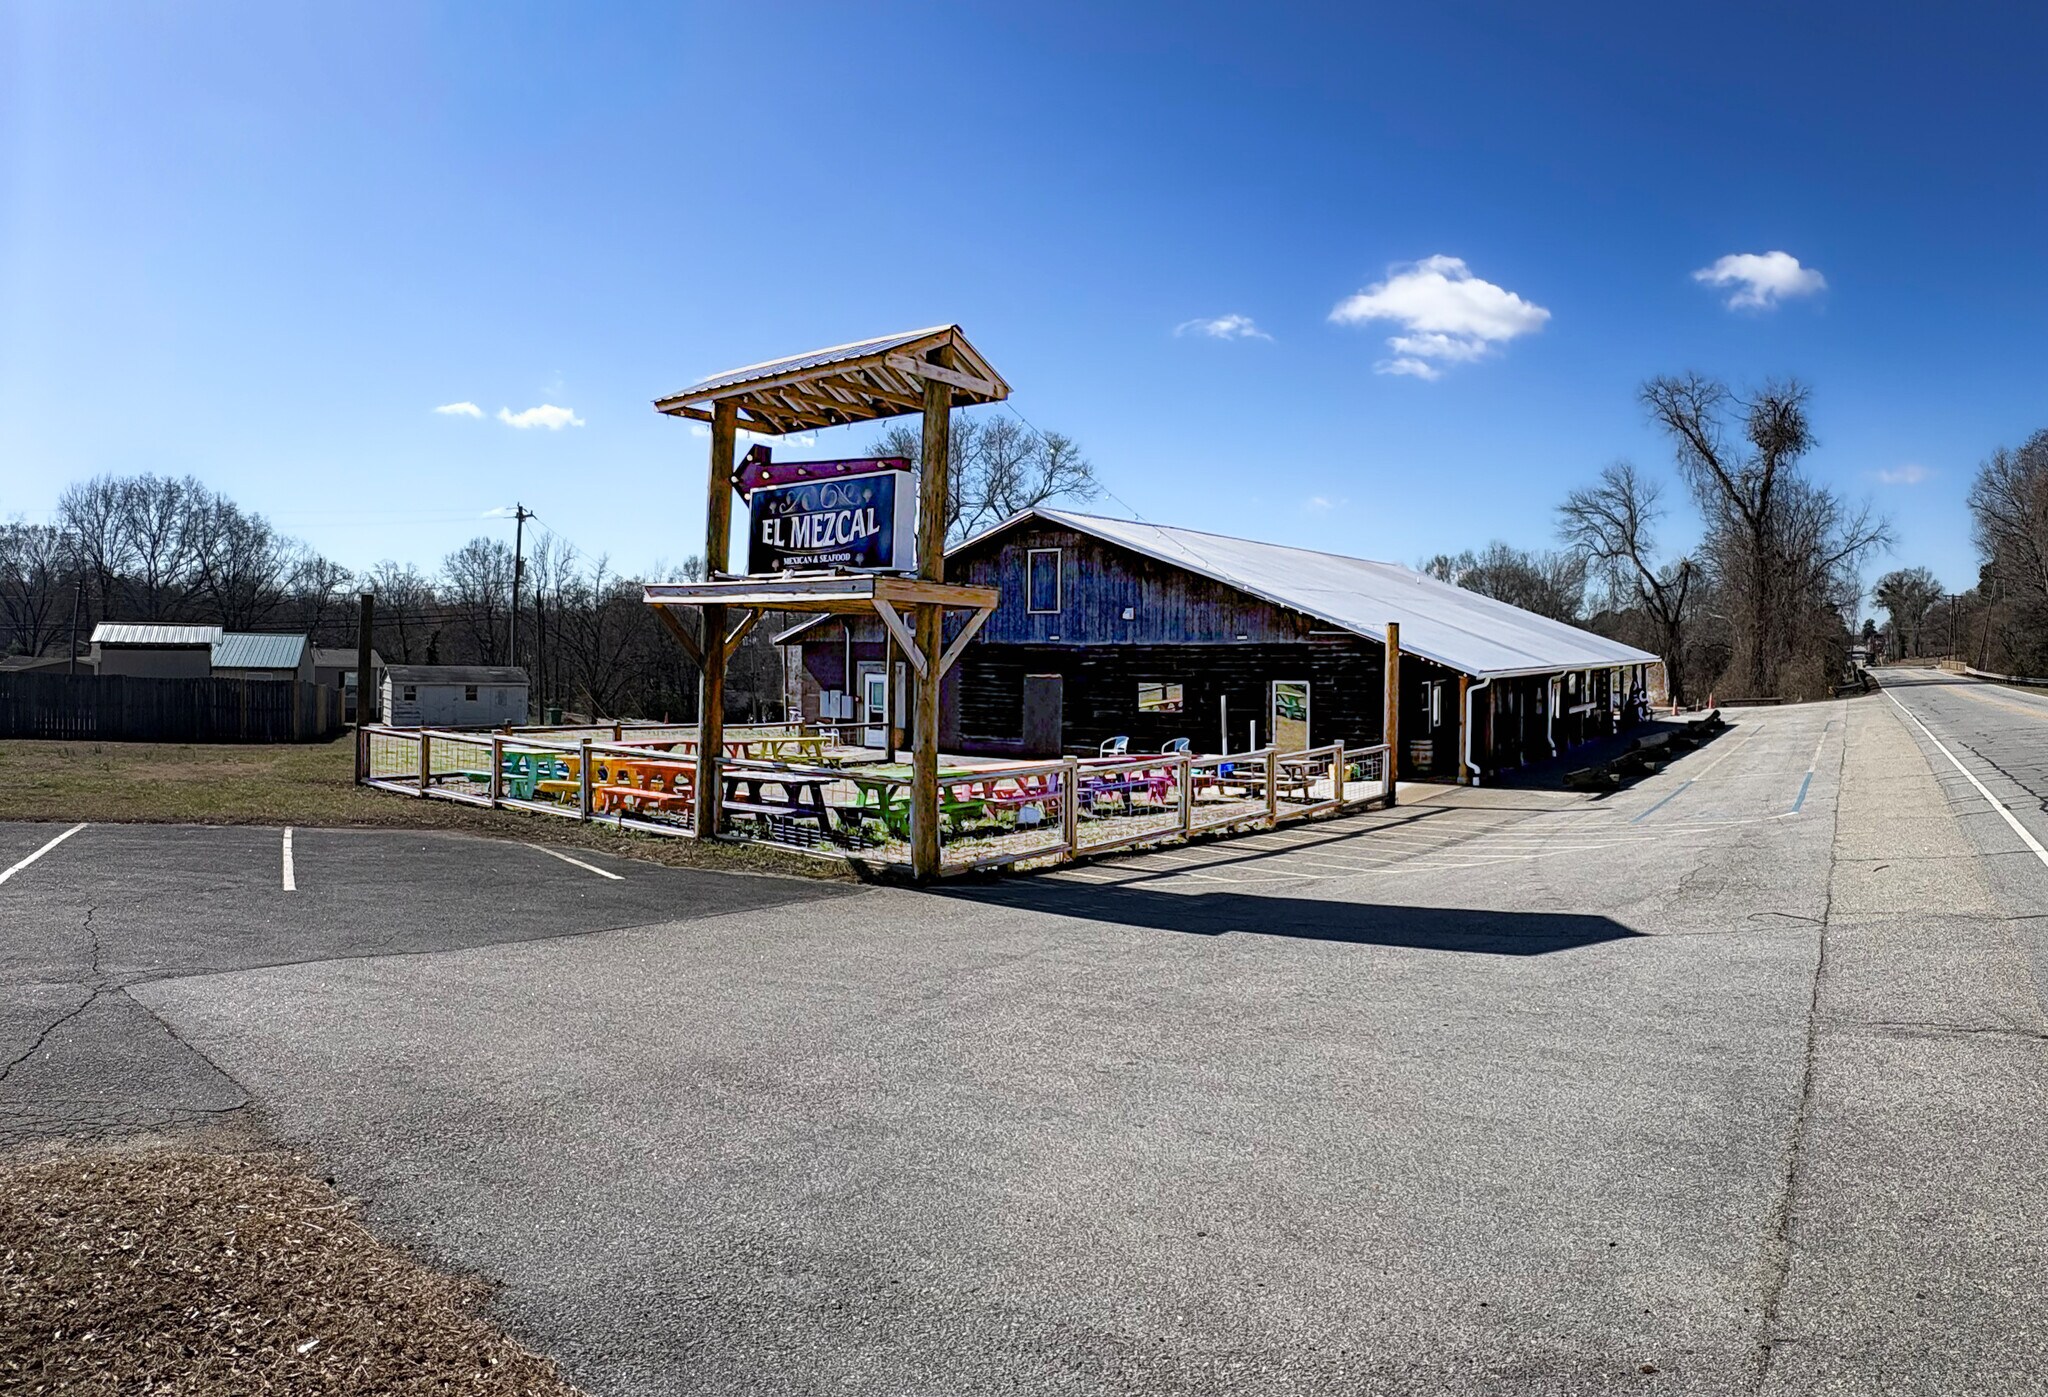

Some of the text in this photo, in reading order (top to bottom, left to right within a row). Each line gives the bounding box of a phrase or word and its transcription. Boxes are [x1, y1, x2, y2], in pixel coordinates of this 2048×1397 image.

[762, 508, 880, 548] EL MEZCAL
[783, 555, 813, 565] MEXICAN
[819, 552, 851, 563] SEAFOOD
